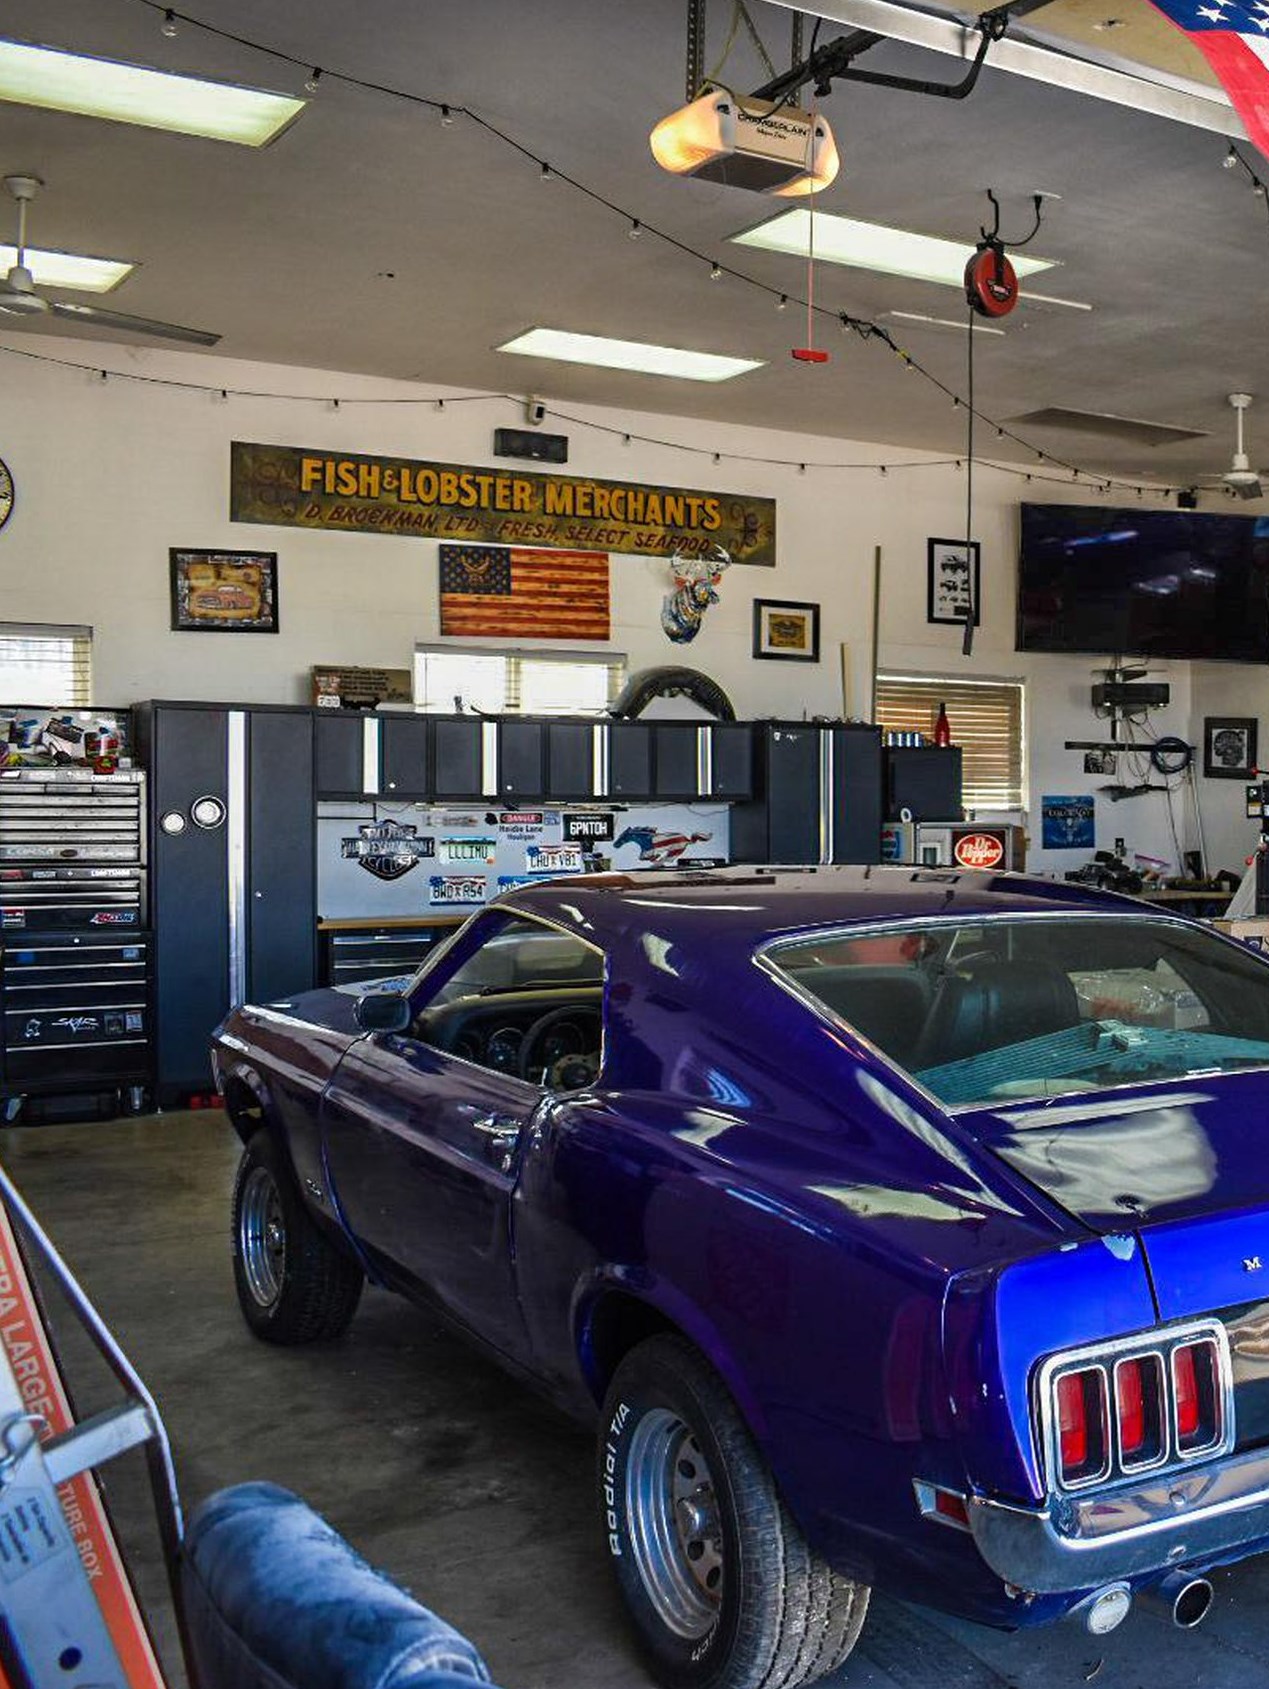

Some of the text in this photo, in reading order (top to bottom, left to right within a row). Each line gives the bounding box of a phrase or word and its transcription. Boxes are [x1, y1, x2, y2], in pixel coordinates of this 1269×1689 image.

[301, 458, 381, 499] FISH
[399, 467, 532, 513] LOBSTER
[545, 481, 722, 532] MERCHANTS
[565, 525, 631, 546] SELECT
[974, 836, 992, 849] Dr
[960, 843, 999, 864] Pepper
[1, 1319, 55, 1421] LARGE
[77, 1538, 103, 1581] BOX
